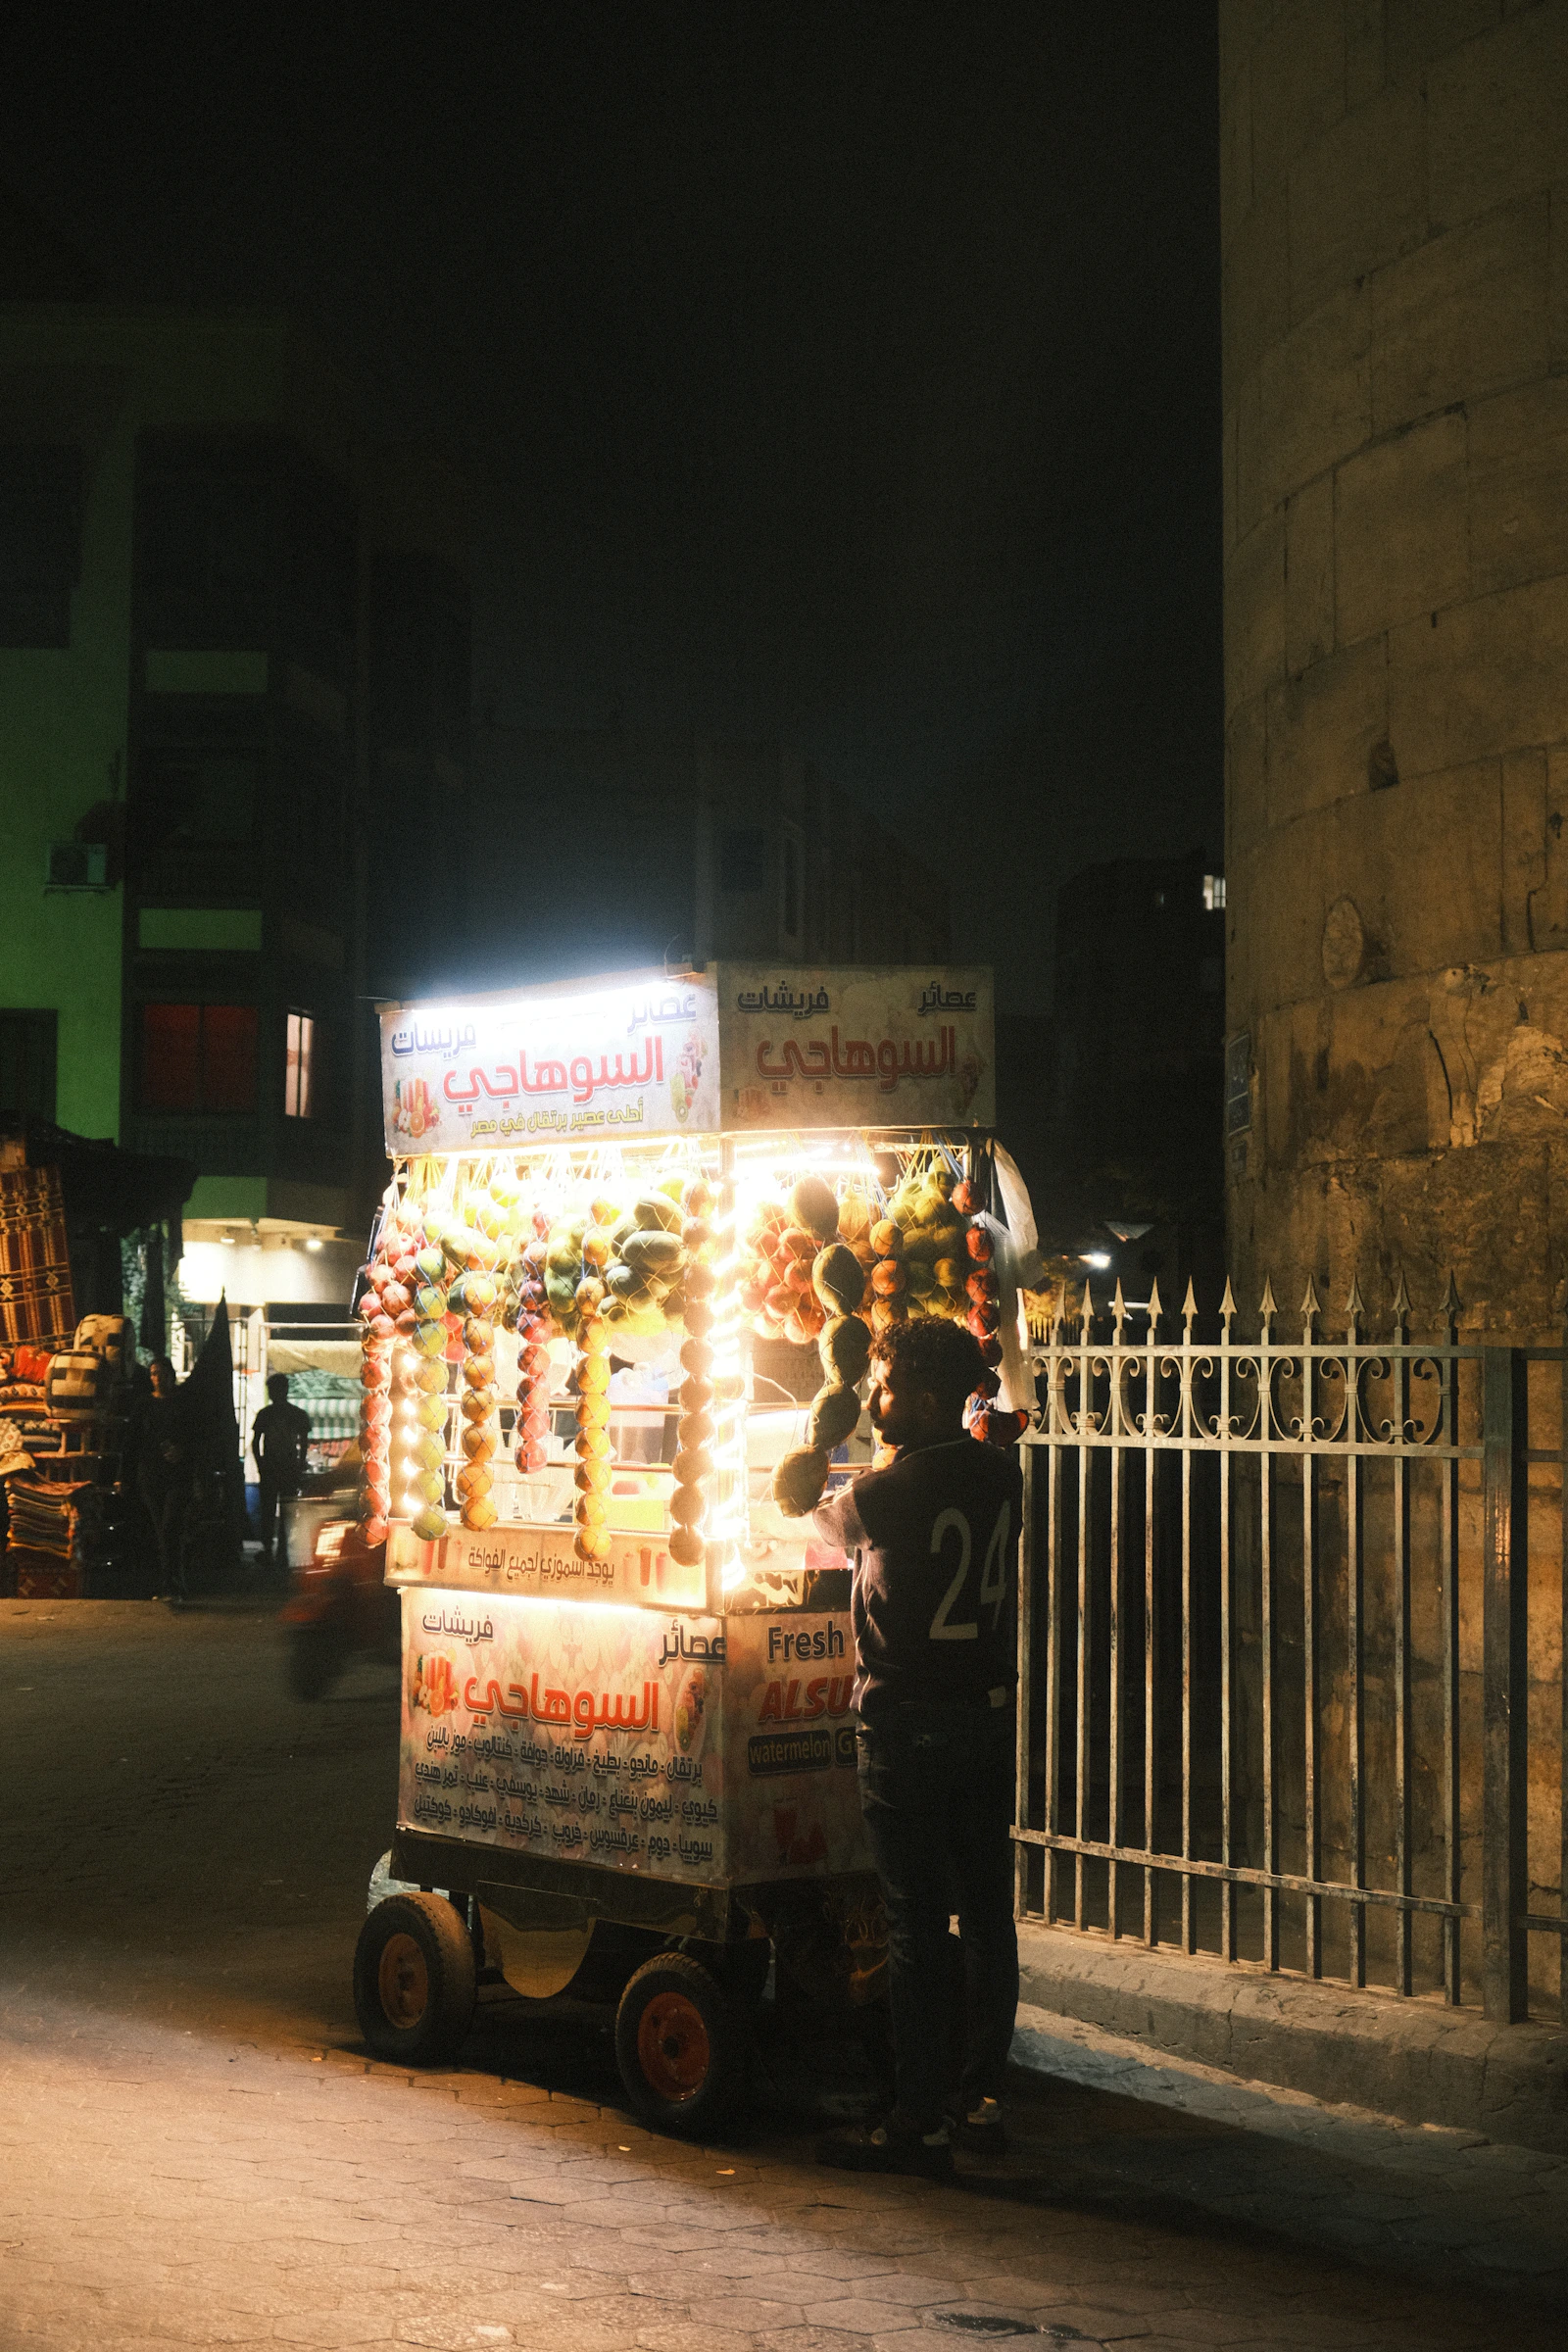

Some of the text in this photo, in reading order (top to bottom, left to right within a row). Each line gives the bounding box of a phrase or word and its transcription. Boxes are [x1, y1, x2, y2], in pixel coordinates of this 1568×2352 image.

[737, 980, 976, 1017] عصائر فريشات
[757, 1025, 956, 1092] السوهاجي
[443, 1035, 663, 1114] السوهاجي
[470, 1097, 643, 1138] أحلى عصير برتقال في مصر
[468, 1546, 506, 1574] الفواكة
[507, 1551, 539, 1580] لجميع
[587, 1560, 614, 1585] يوجد
[928, 1499, 1010, 1640] 24
[422, 1605, 726, 1666] عصائر فريشات
[767, 1620, 845, 1660] Fresh
[464, 1672, 661, 1740] السوهاجي
[758, 1675, 855, 1721] ALSU
[451, 1730, 466, 1754] موز
[473, 1736, 513, 1760] كنتالوب
[520, 1740, 548, 1769] جوافة
[749, 1734, 830, 1764] watermelon
[838, 1731, 858, 1755] G
[554, 1745, 585, 1774] فراولة
[593, 1749, 621, 1778] بطيخ
[628, 1753, 659, 1779] مانجو
[666, 1756, 703, 1787] برتقال
[414, 1794, 451, 1822] كوكتيل
[415, 1761, 718, 1826] كيوي ليمون بنعناع رمان شهد يوسفي عنب تمر هندي
[552, 1822, 582, 1846] خروب
[590, 1827, 639, 1852] عرقسوس
[648, 1835, 671, 1858] دوم
[678, 1835, 712, 1862] سوبيا
